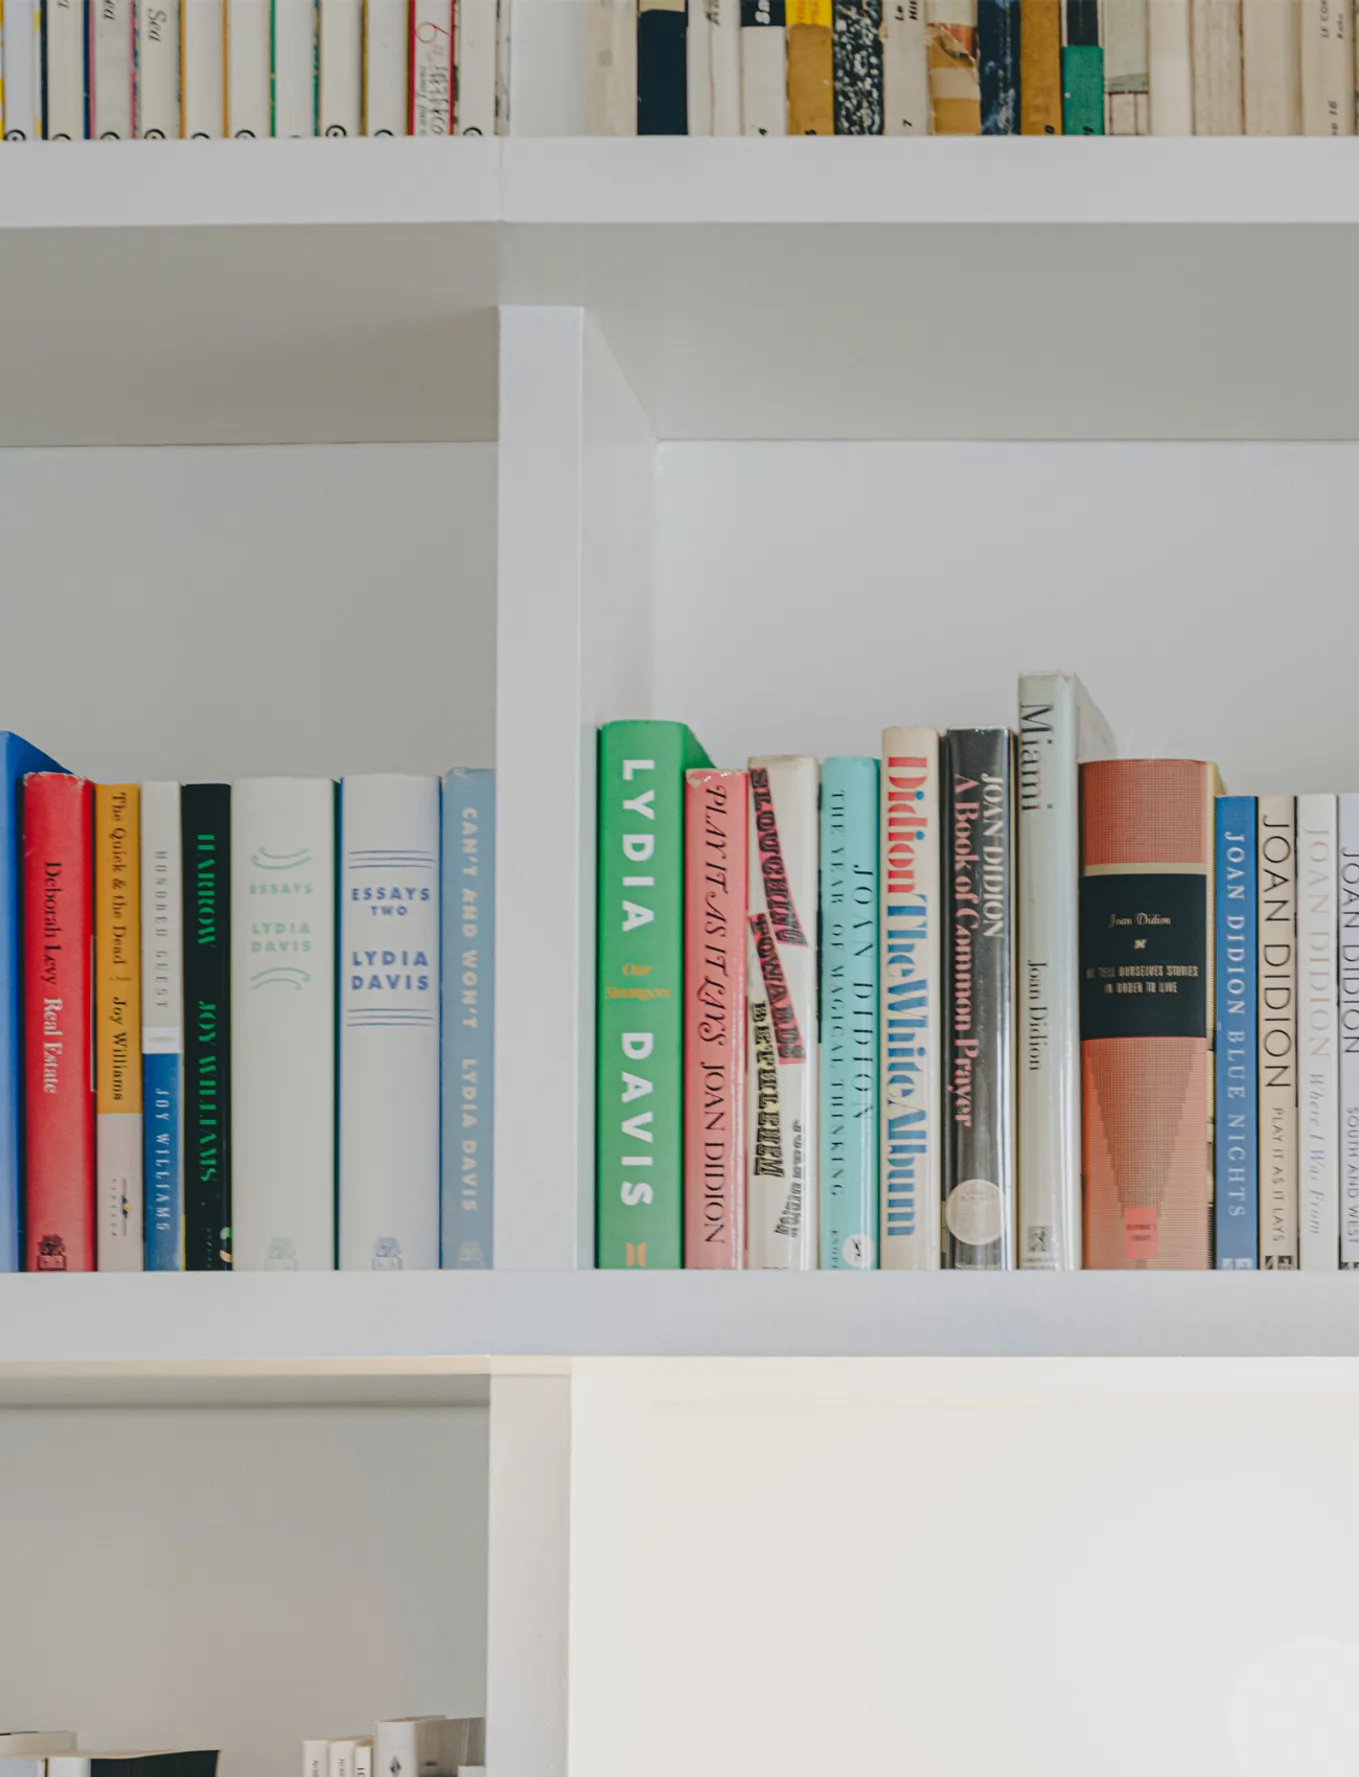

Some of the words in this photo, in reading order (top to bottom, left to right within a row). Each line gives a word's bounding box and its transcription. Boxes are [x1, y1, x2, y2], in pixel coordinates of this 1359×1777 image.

[1020, 702, 1055, 813] Miami
[111, 793, 127, 821] The
[955, 775, 977, 795] A
[621, 760, 655, 932] LYDIA
[704, 785, 727, 860] PLAY
[955, 801, 980, 870] Book
[110, 827, 127, 873] Quick
[43, 861, 64, 939] Deborah
[197, 834, 215, 950] HARROW
[351, 888, 431, 902] ESSAYS
[704, 863, 727, 896] IT
[955, 875, 980, 904] of
[112, 896, 127, 921] the
[370, 906, 407, 917] TWO
[461, 889, 478, 939] AND
[40, 945, 63, 986] Levy
[112, 926, 127, 965] Dead
[352, 951, 428, 968] LYDIA
[704, 945, 728, 977] IT
[955, 908, 979, 1032] Common
[351, 975, 430, 991] DAVIS
[43, 999, 63, 1037] Real
[43, 1042, 63, 1094] Estate
[947, 1039, 979, 1127] Prayer
[1226, 1030, 1246, 1099] BLUE
[620, 1032, 655, 1208] DAVIS
[702, 1061, 727, 1132] JOAN
[1225, 1113, 1246, 1218] NIGHTS
[702, 1142, 728, 1244] DIDION
